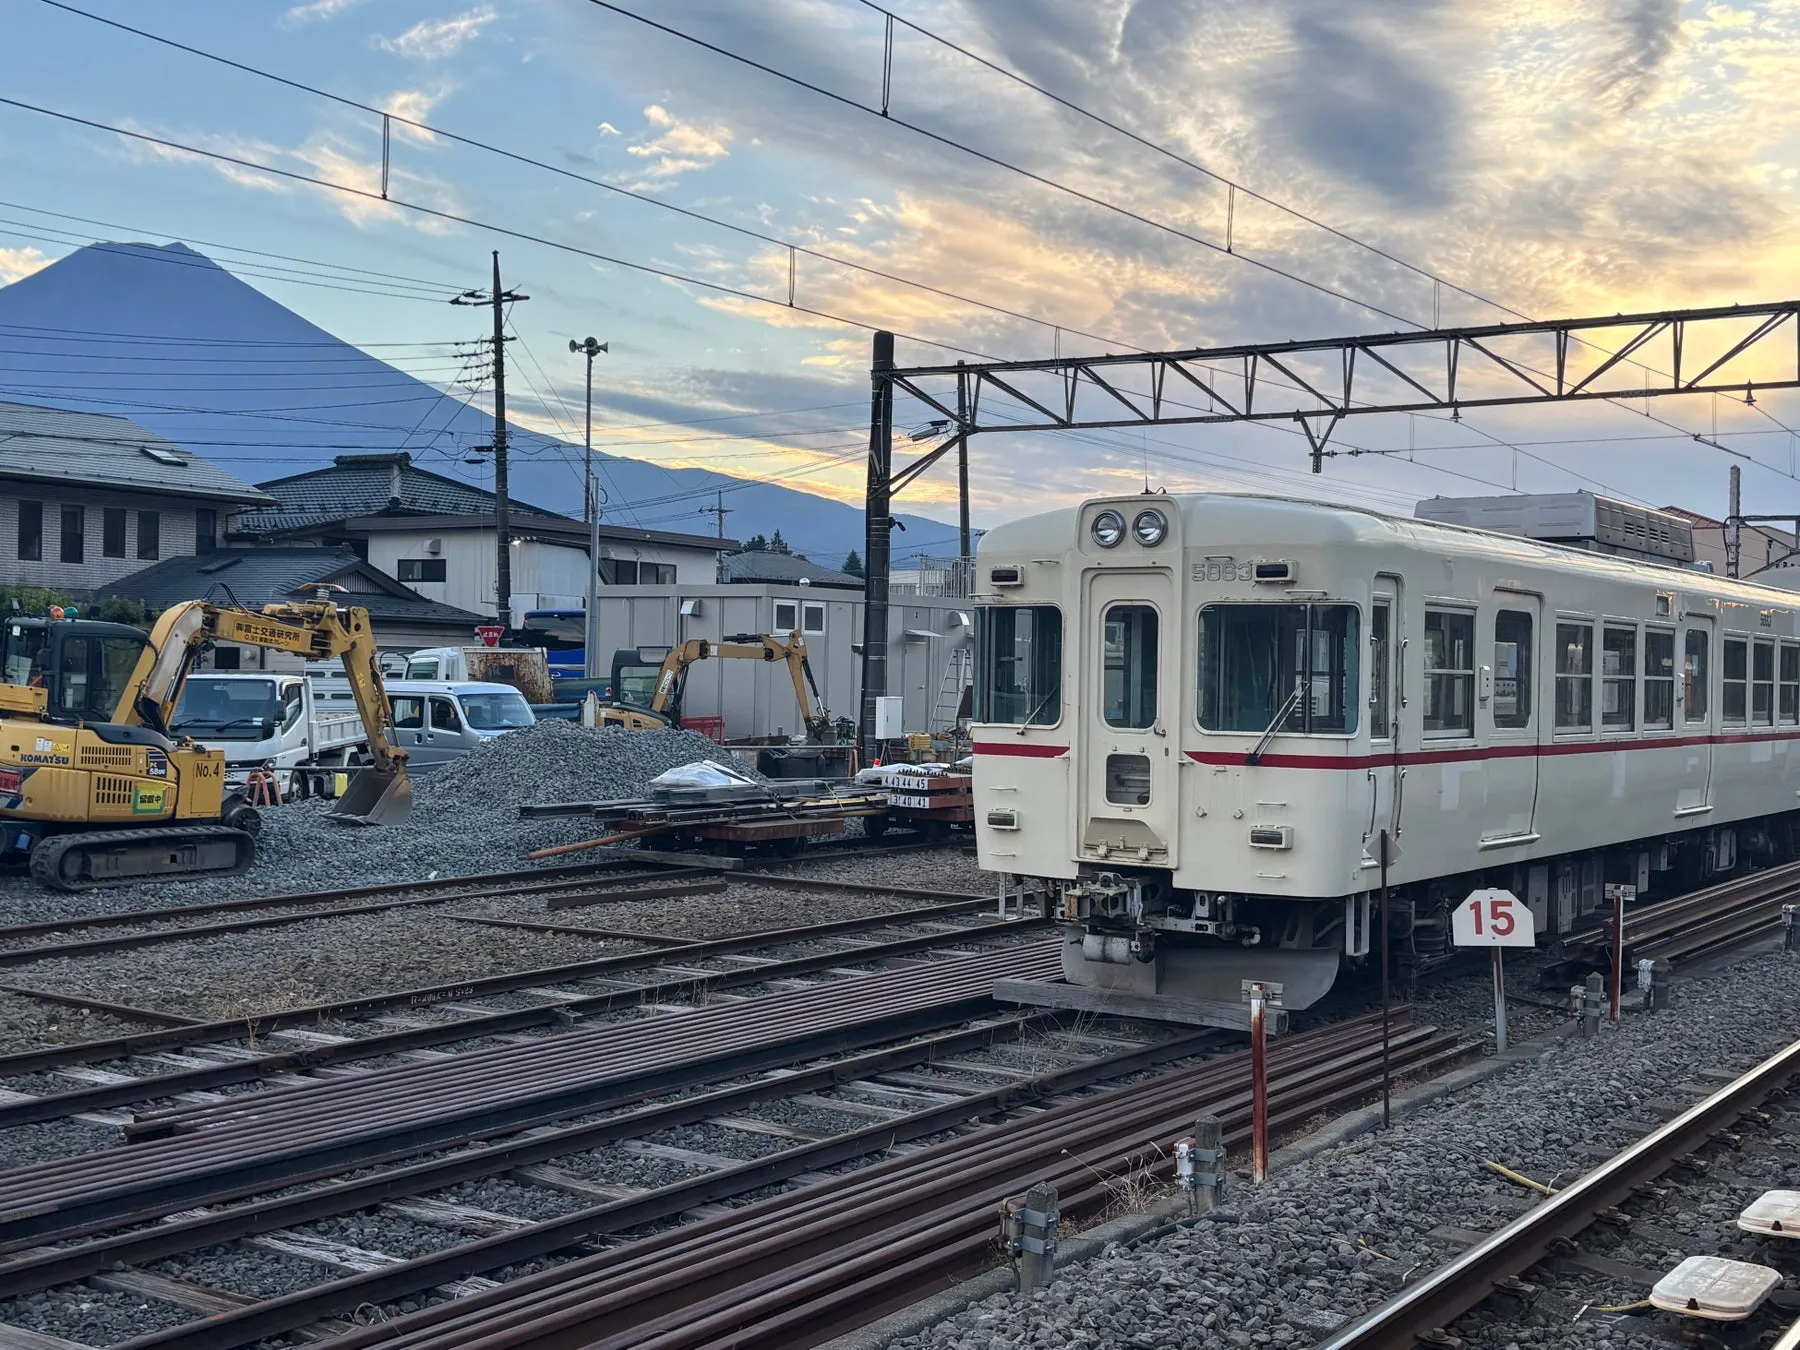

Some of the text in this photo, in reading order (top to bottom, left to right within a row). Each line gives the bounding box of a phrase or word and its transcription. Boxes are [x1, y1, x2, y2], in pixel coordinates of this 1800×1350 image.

[20, 754, 69, 765] KOMATSU
[902, 777, 911, 787] 44
[916, 778, 925, 789] 45
[917, 798, 926, 808] 41
[1469, 900, 1515, 936] 15
